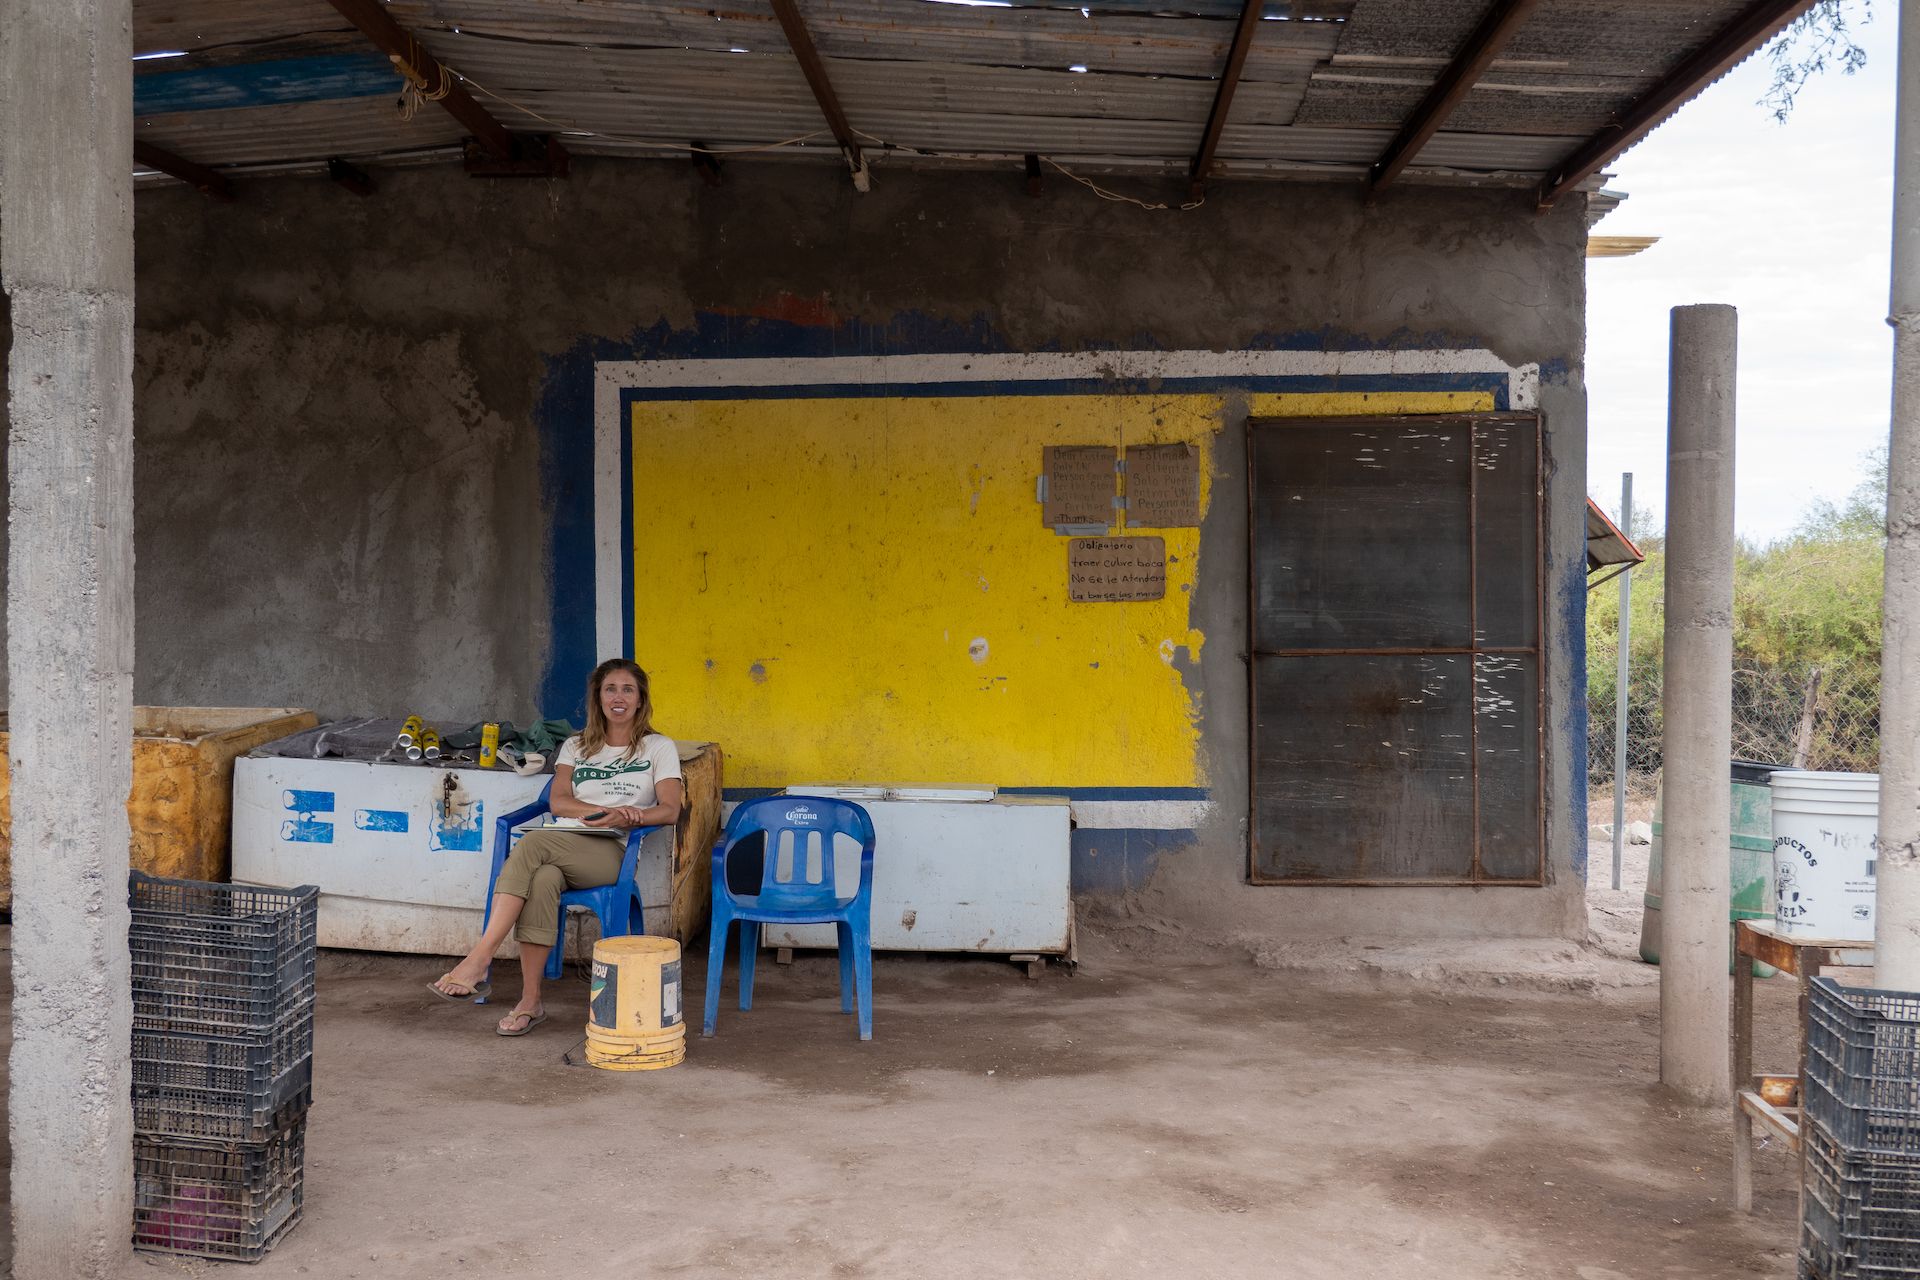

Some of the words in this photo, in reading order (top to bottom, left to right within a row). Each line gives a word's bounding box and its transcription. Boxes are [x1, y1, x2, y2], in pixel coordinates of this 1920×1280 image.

[1079, 540, 1133, 550] Obligatorio
[1071, 556, 1100, 567] traer
[1137, 557, 1163, 567] boca
[1071, 573, 1086, 583] No
[785, 811, 818, 821] Corona
[1773, 836, 1818, 867] ODUCTOS
